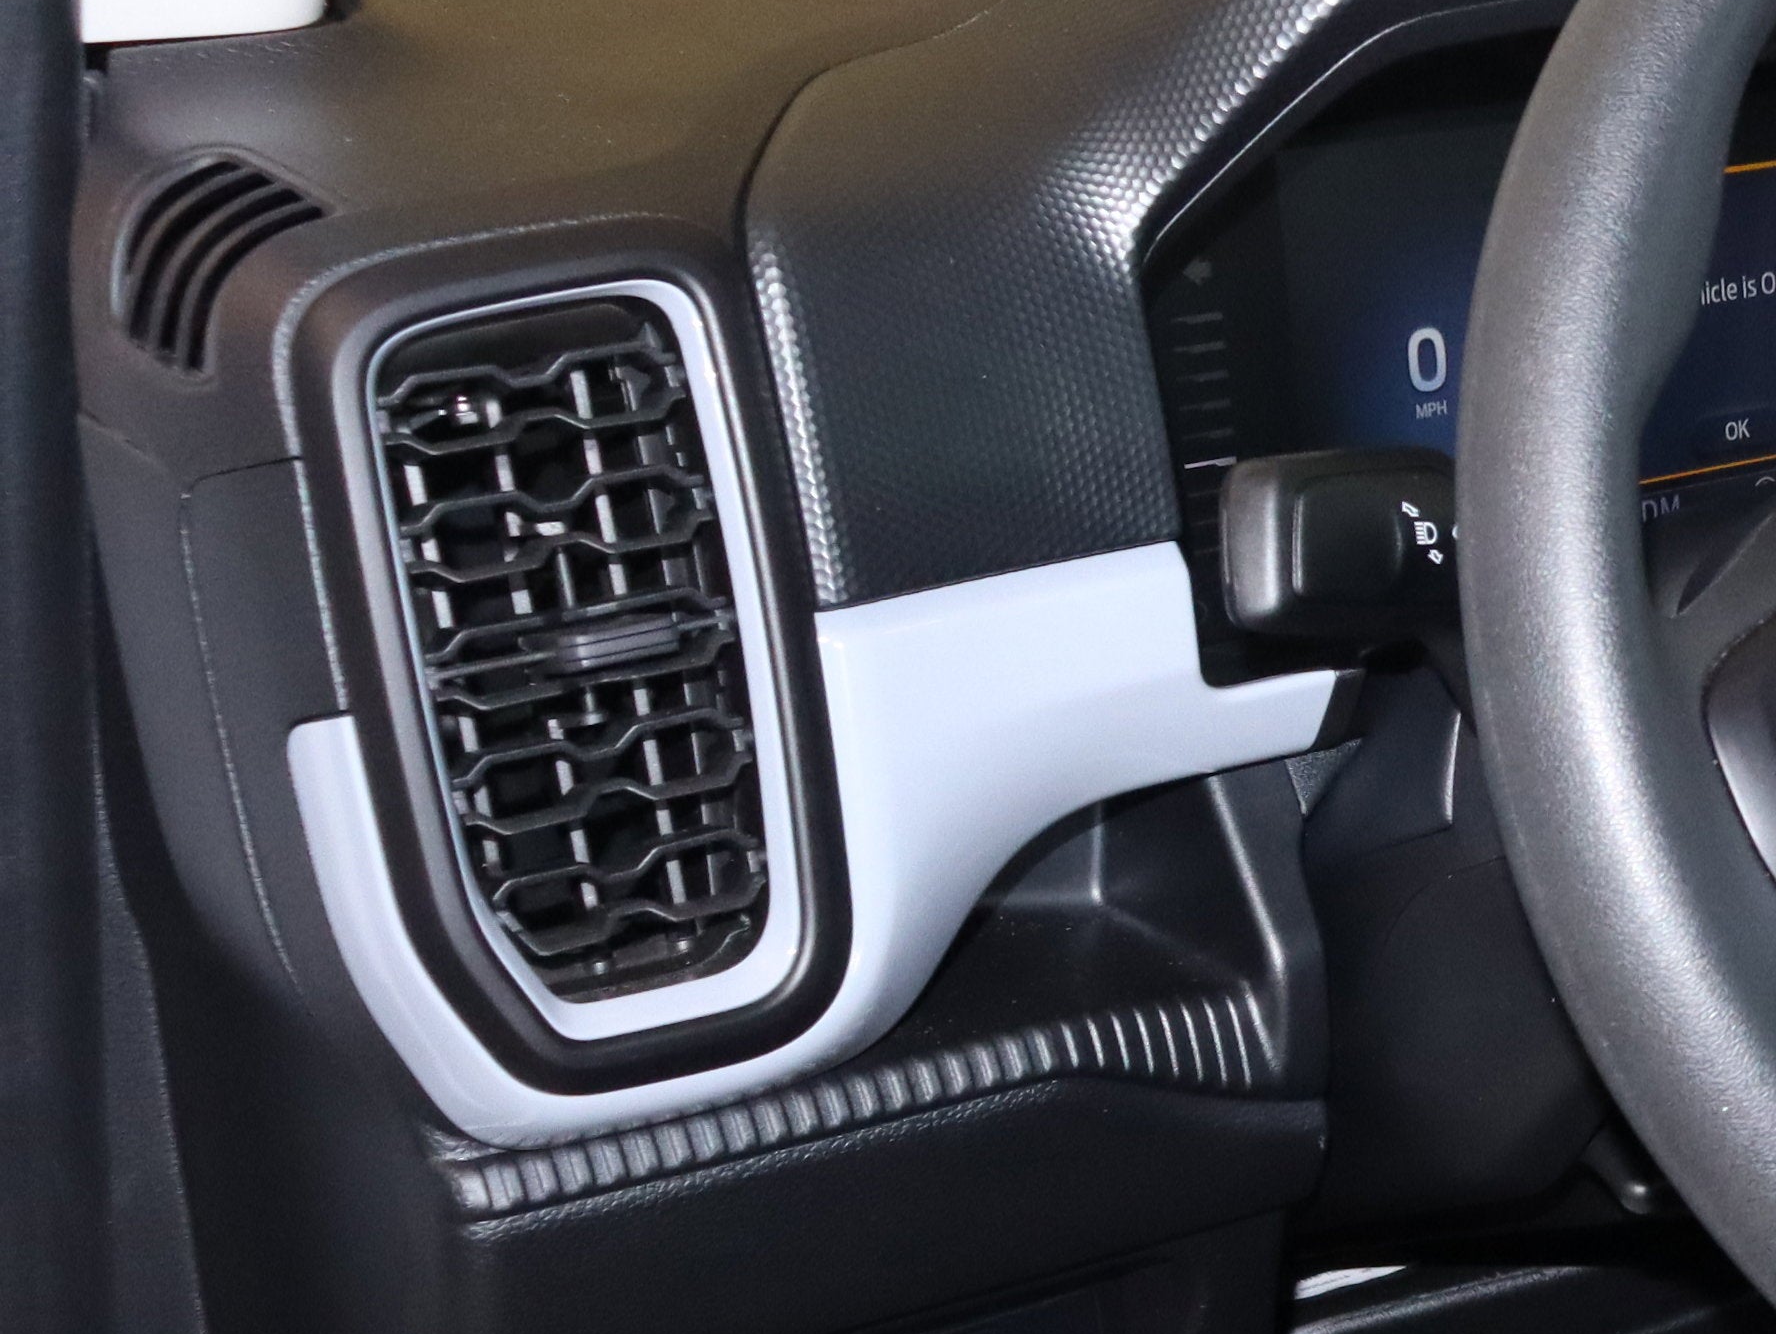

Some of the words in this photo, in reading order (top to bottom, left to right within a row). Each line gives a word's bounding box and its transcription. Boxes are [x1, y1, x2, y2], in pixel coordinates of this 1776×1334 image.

[1742, 275, 1757, 299] is
[1408, 327, 1447, 392] 0
[1415, 399, 1448, 419] MPH
[1725, 418, 1750, 441] OK
